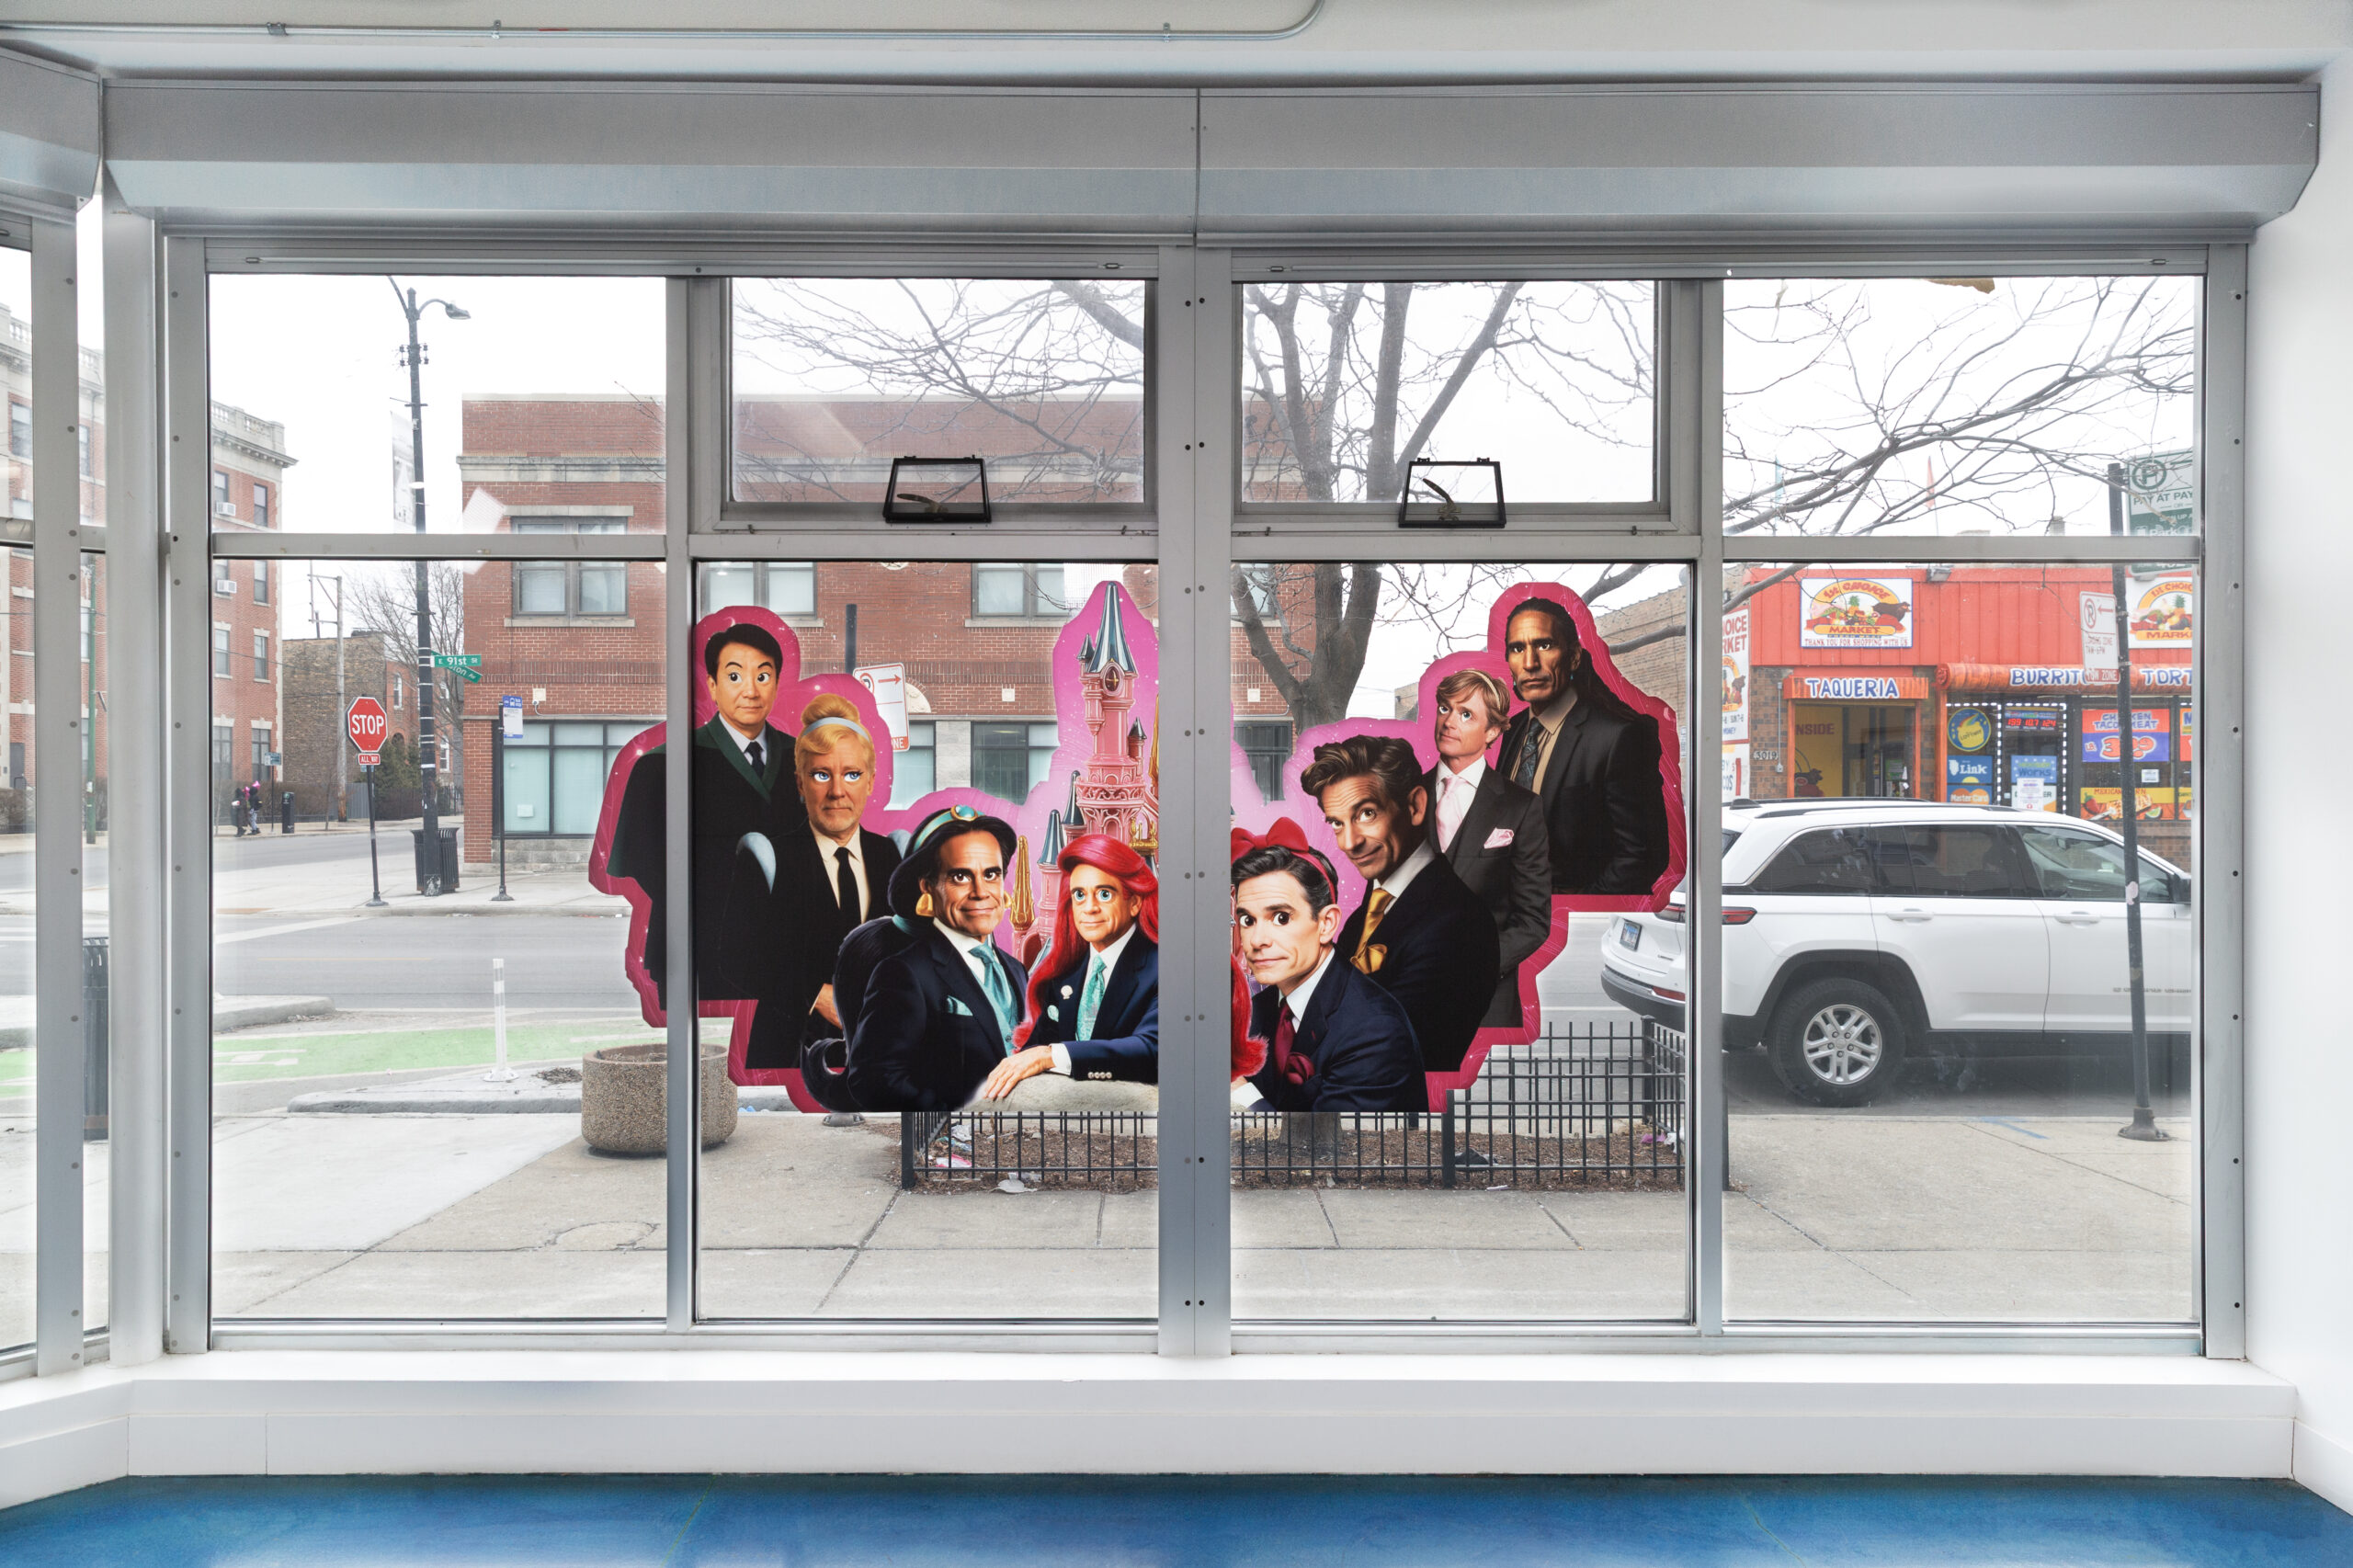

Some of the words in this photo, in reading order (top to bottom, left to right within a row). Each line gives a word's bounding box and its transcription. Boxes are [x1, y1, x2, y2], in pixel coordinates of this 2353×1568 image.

[2156, 493, 2170, 503] AT
[1842, 581, 1891, 599] CHOICE
[1829, 626, 1881, 634] MARKET
[447, 656, 467, 665] 91st
[2101, 670, 2118, 681] ZONE
[1806, 677, 1899, 699] TAQUERIA
[351, 715, 384, 734] STOP
[1756, 751, 1777, 759] 3019
[1960, 764, 1987, 774] Link
[1950, 793, 1988, 802] MasterCard
